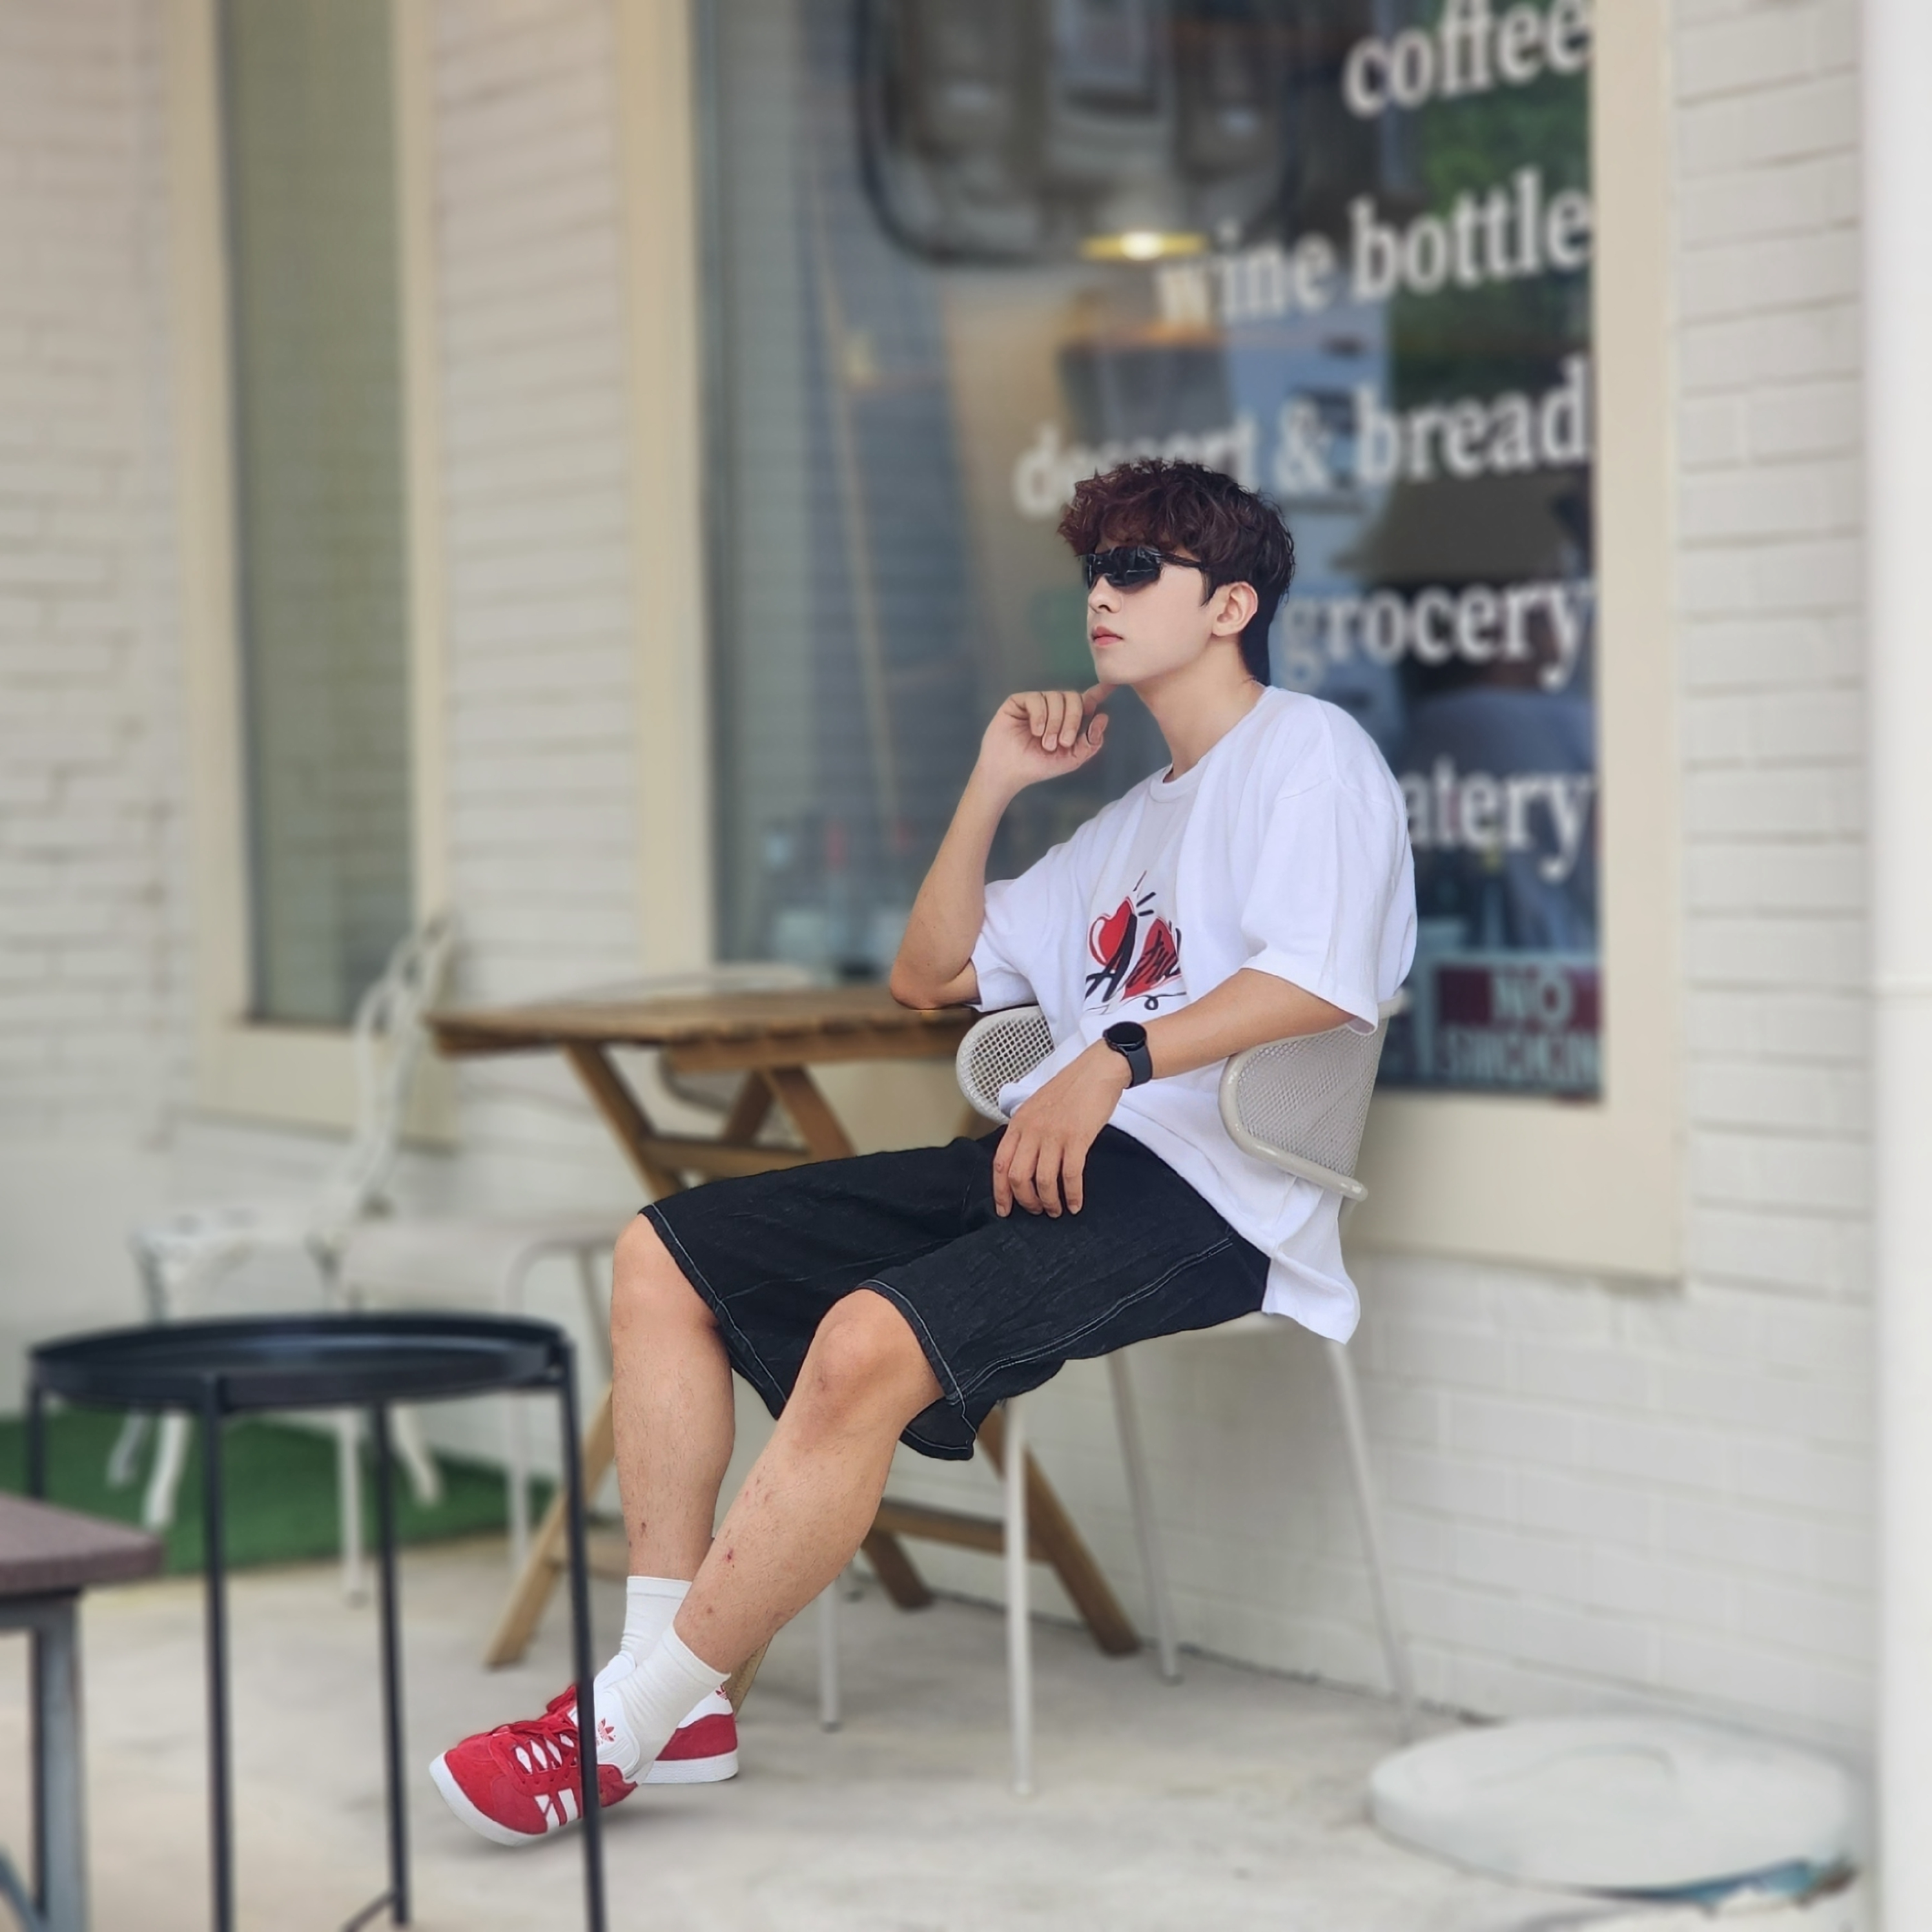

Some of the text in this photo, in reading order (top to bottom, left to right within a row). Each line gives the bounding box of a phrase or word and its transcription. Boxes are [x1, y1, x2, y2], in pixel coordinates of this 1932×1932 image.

[1343, 0, 1591, 118] coffee
[1156, 165, 1591, 325] wine bottle
[1273, 395, 1333, 496] &
[1355, 354, 1587, 480] bread
[1284, 580, 1594, 691] grocery
[1399, 753, 1592, 883] atery
